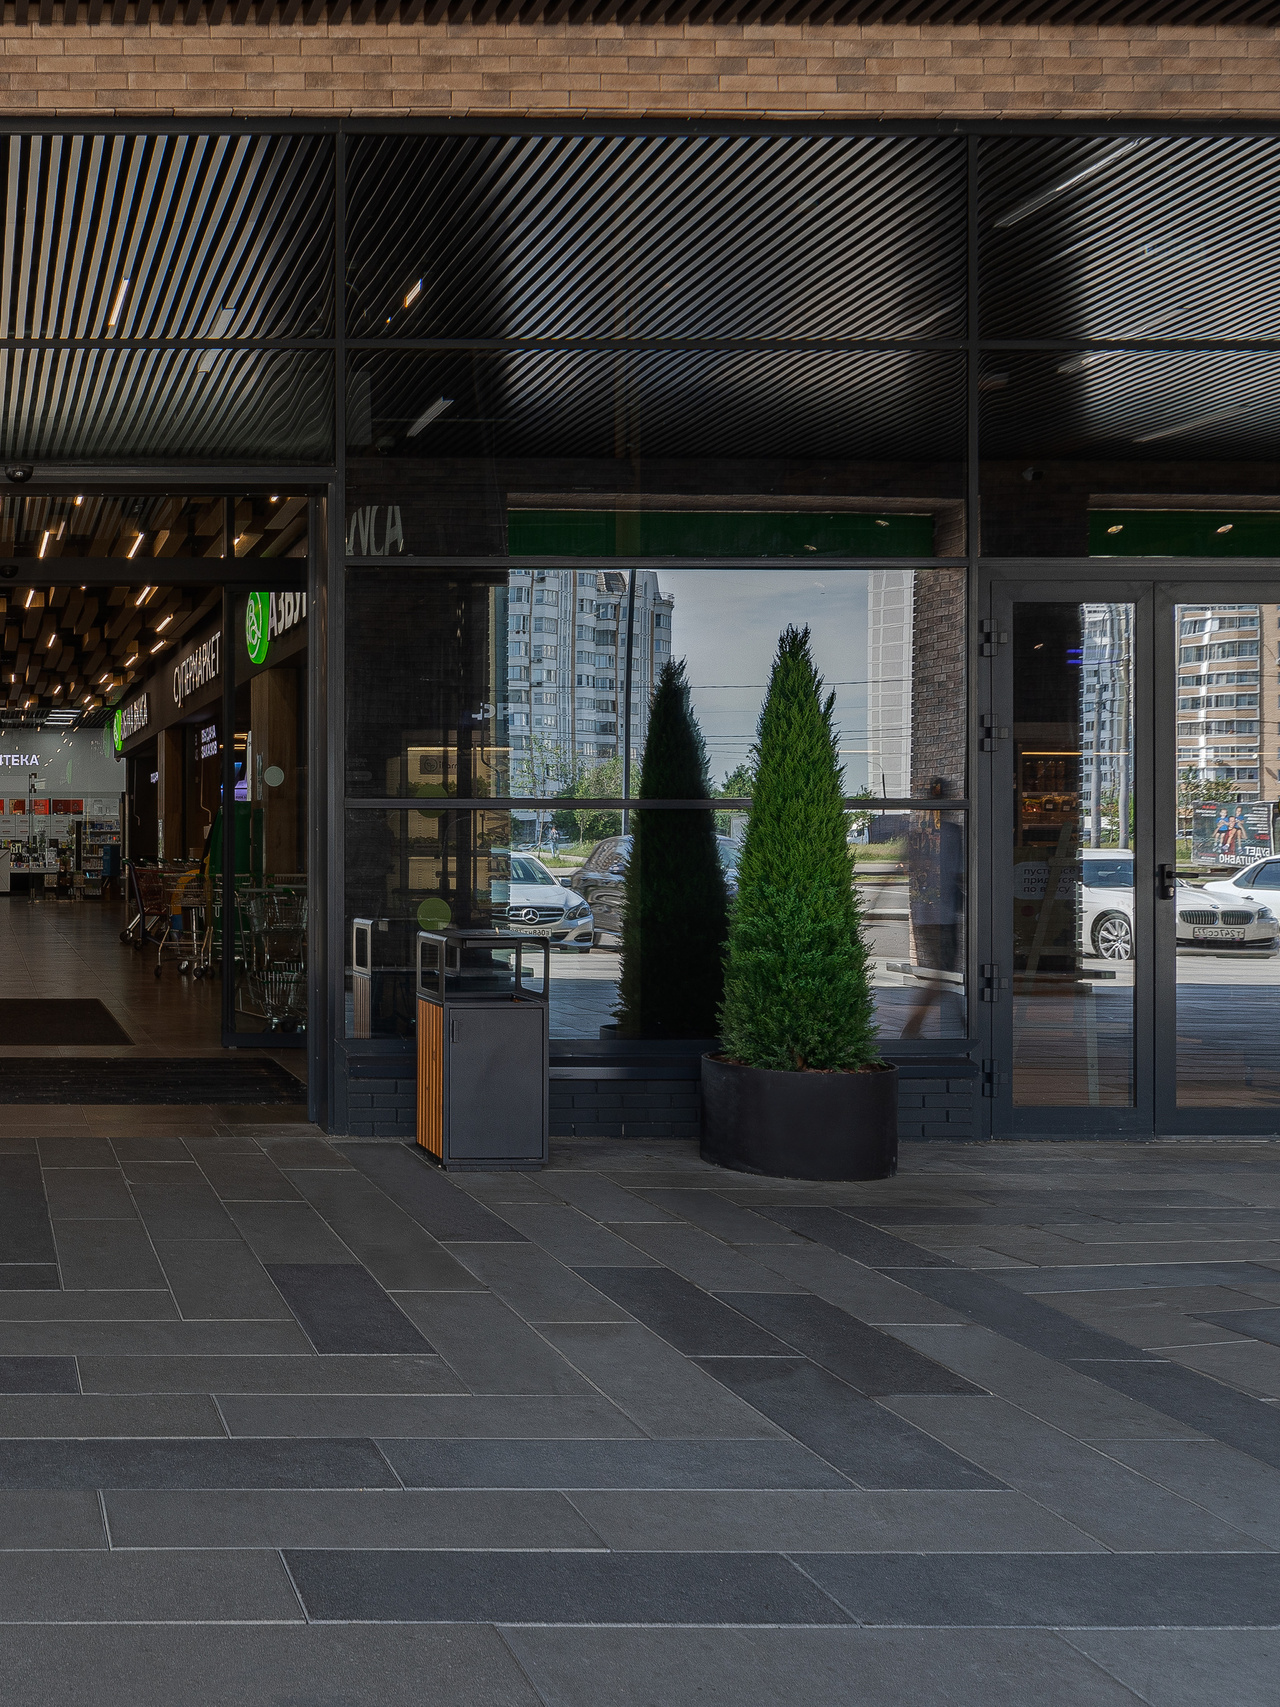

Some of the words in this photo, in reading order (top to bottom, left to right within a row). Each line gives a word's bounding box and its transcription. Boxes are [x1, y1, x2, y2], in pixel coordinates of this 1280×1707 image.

[267, 592, 307, 641] АЗБУ
[173, 630, 221, 708] СУПЕРМАРКЕТ
[1040, 886, 1071, 894] всу
